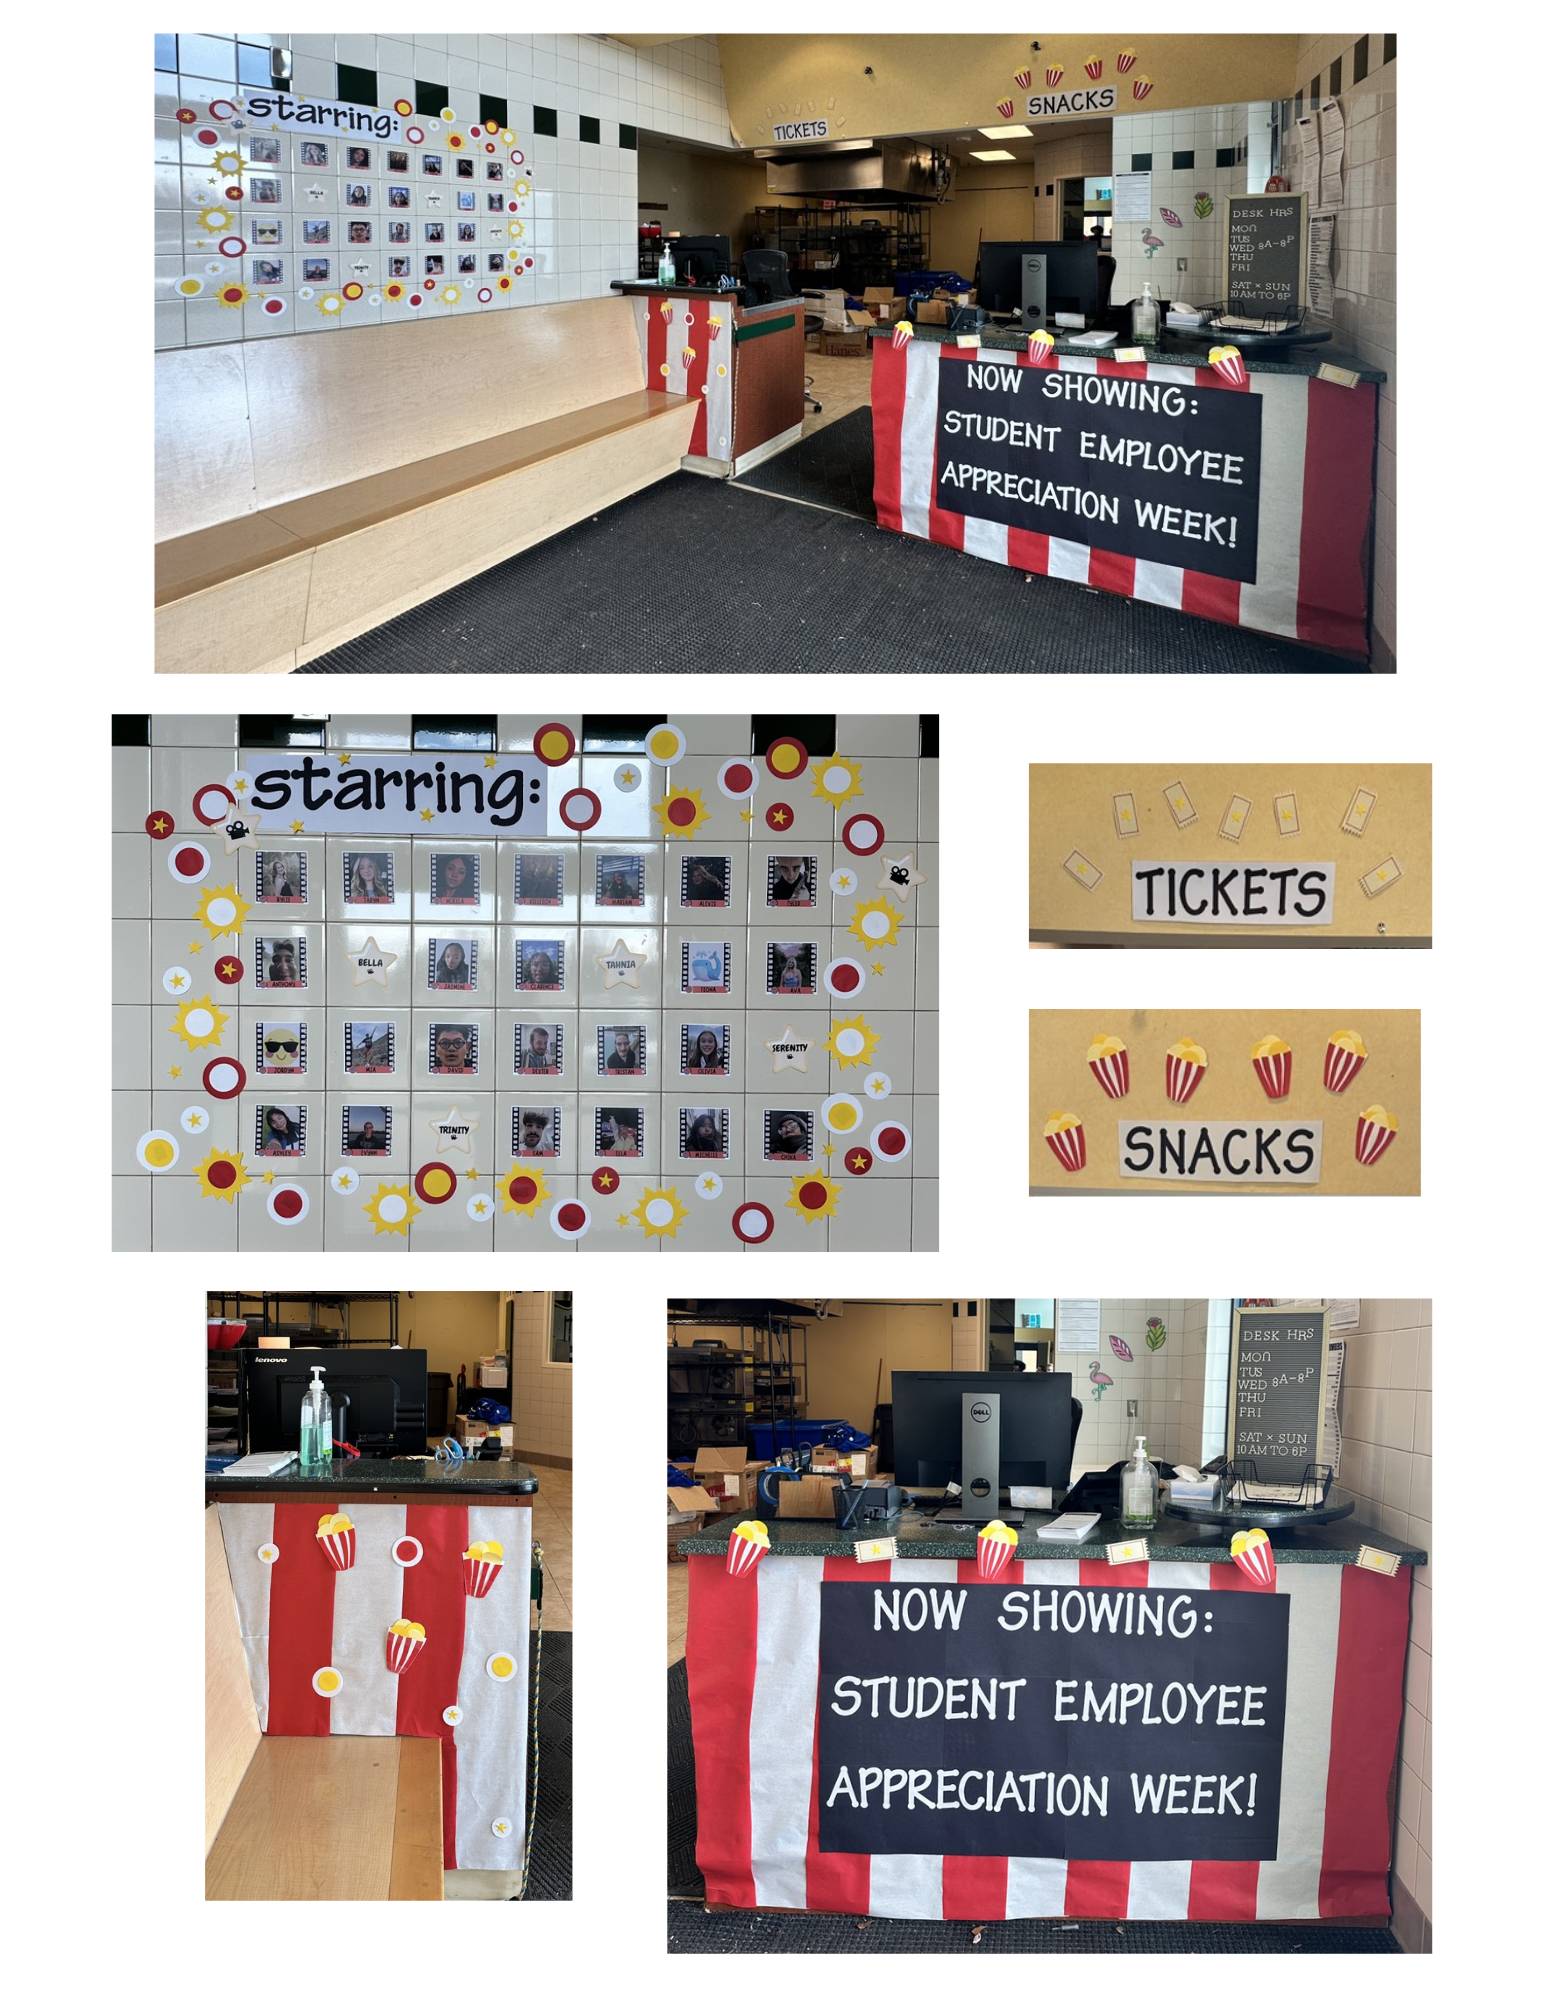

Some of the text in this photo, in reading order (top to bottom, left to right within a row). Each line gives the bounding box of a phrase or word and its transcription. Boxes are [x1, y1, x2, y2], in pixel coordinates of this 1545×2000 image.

[1028, 89, 1114, 116] SNACKS
[247, 94, 399, 138] starring:
[774, 121, 827, 140] TICKETS
[1233, 207, 1294, 218] DESK HRS
[1230, 235, 1251, 243] TUS
[1229, 244, 1255, 253] WED
[1230, 253, 1254, 261] THU
[1231, 263, 1250, 272] FRI
[1231, 281, 1253, 289] SAT
[1265, 283, 1291, 292] SUN
[1258, 292, 1275, 300] TO
[967, 363, 1199, 417] NOW SHOWING:
[943, 410, 1244, 485] STUDENT EMPLOYEE
[940, 461, 1238, 549] APPRECIATION WEEK!
[251, 756, 541, 827] starring:
[1135, 867, 1327, 918] TICKETS
[358, 958, 384, 967] BELLA
[606, 960, 636, 969] TAHNIA
[272, 980, 296, 988] ANTHONY
[772, 1043, 808, 1052] SERENITY
[447, 1066, 464, 1074] DAVID
[439, 1126, 470, 1135] TRINITY
[272, 1149, 292, 1157] ASHLEY
[1124, 1125, 1316, 1175] SNACKS
[1243, 1328, 1314, 1342] DESK HRS
[1239, 1367, 1263, 1378] TUS
[1238, 1379, 1268, 1390] WED
[1238, 1392, 1267, 1403] THU
[1239, 1407, 1262, 1418] FRI
[1239, 1432, 1263, 1442] SAT
[1278, 1433, 1307, 1444] SUN
[1270, 1445, 1289, 1457] TO
[872, 1587, 1214, 1639] NOW SHOWING:
[830, 1674, 1268, 1727] STUDENT EMPLOYEE
[825, 1764, 1258, 1817] APPRECIATION WEEK!
